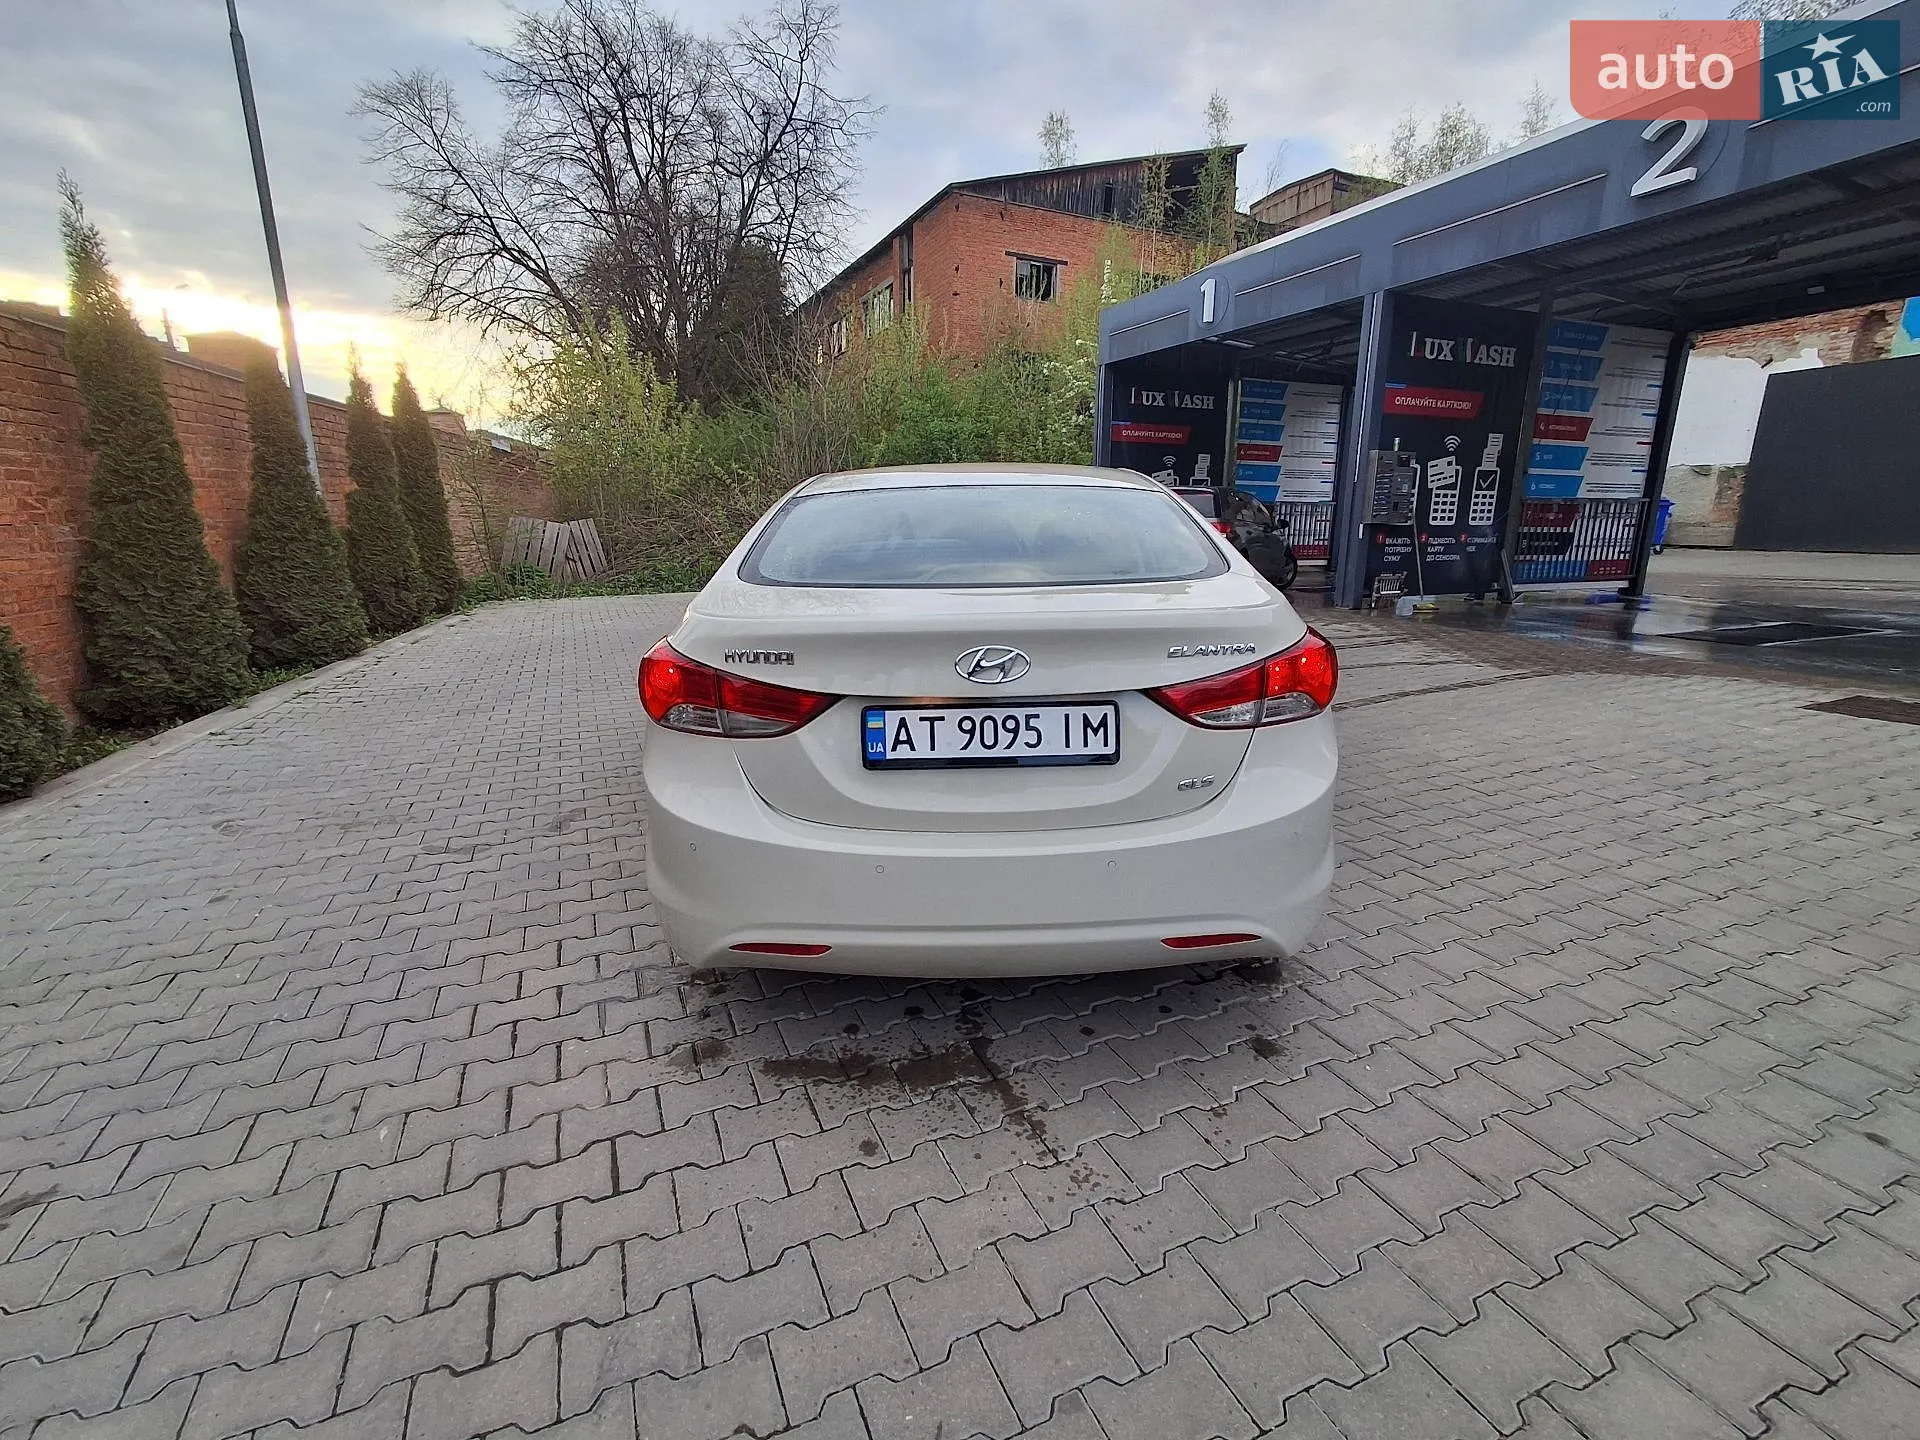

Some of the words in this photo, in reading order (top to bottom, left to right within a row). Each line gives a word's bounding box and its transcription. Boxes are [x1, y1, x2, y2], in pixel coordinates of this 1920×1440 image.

[1629, 105, 1709, 198] 2
[1199, 278, 1217, 324] 1
[1394, 396, 1437, 408] ОПЛАЧУЙТЕ
[724, 648, 795, 666] HYUNDAI
[1167, 642, 1257, 658] ELANTRA
[890, 715, 946, 753] AT
[957, 712, 1043, 751] 9095
[1063, 711, 1109, 749] IM
[867, 742, 885, 754] UA
